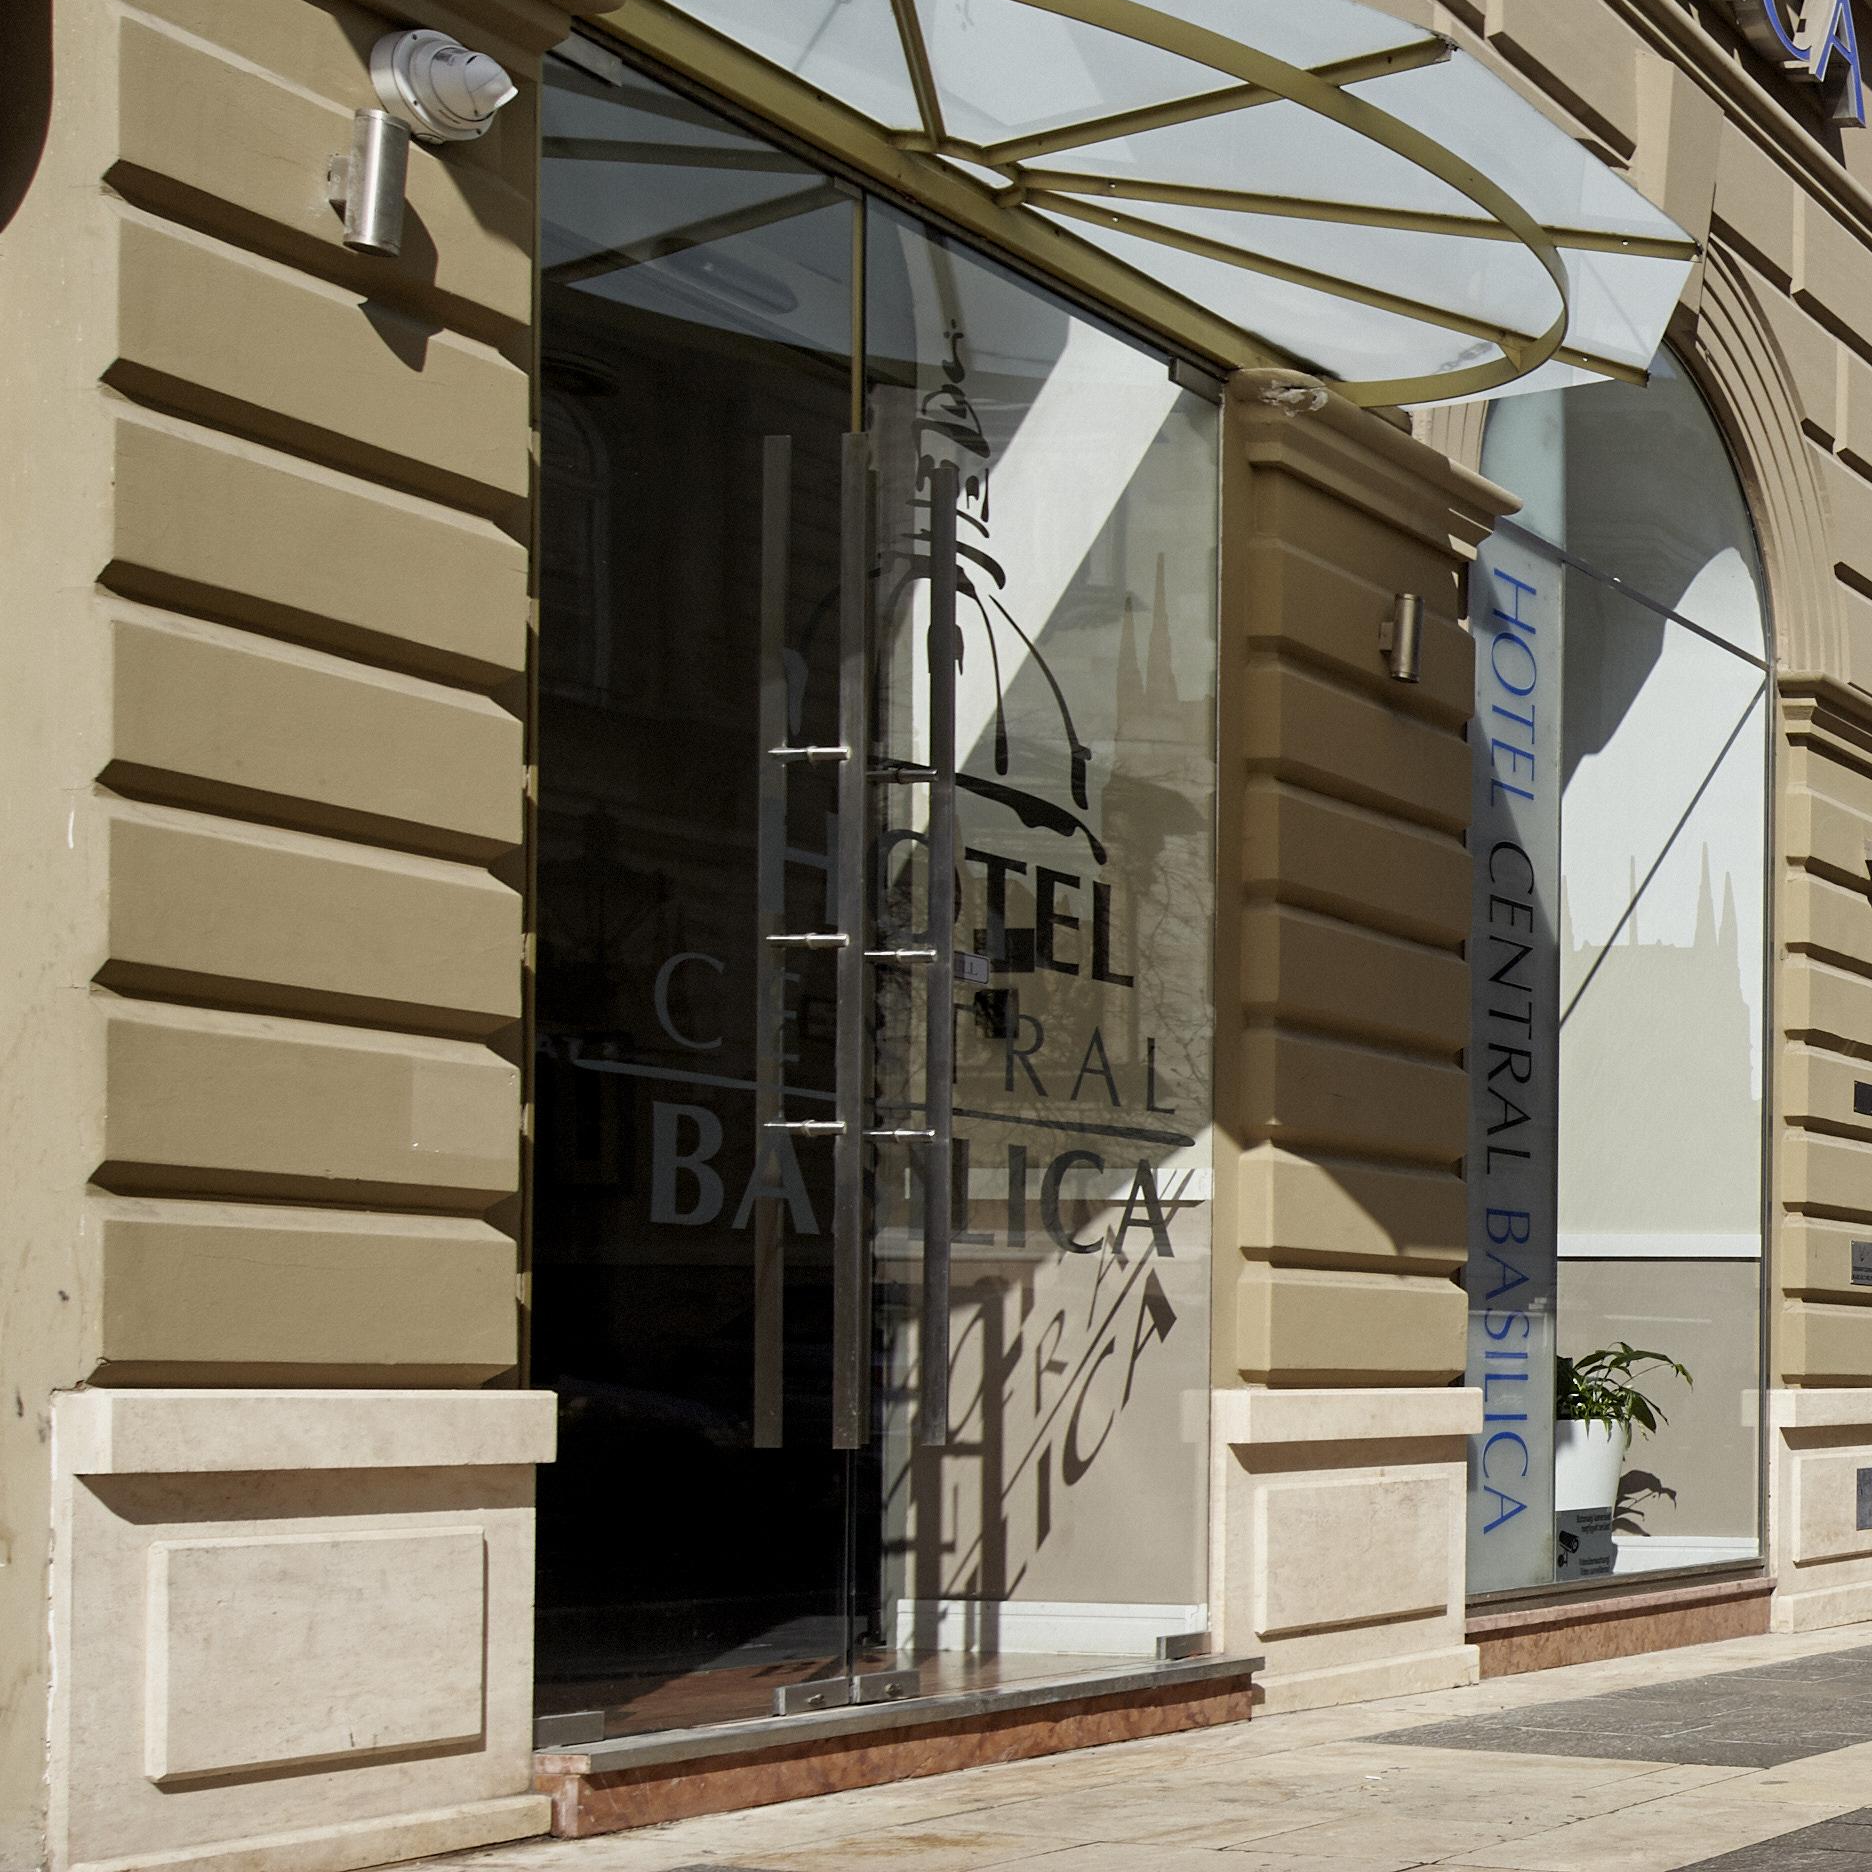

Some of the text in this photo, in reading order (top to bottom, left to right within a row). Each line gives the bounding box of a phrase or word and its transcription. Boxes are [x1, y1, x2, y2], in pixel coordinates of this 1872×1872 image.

[1480, 568, 1537, 1538] HOTEL CENTRAL BASILICA
